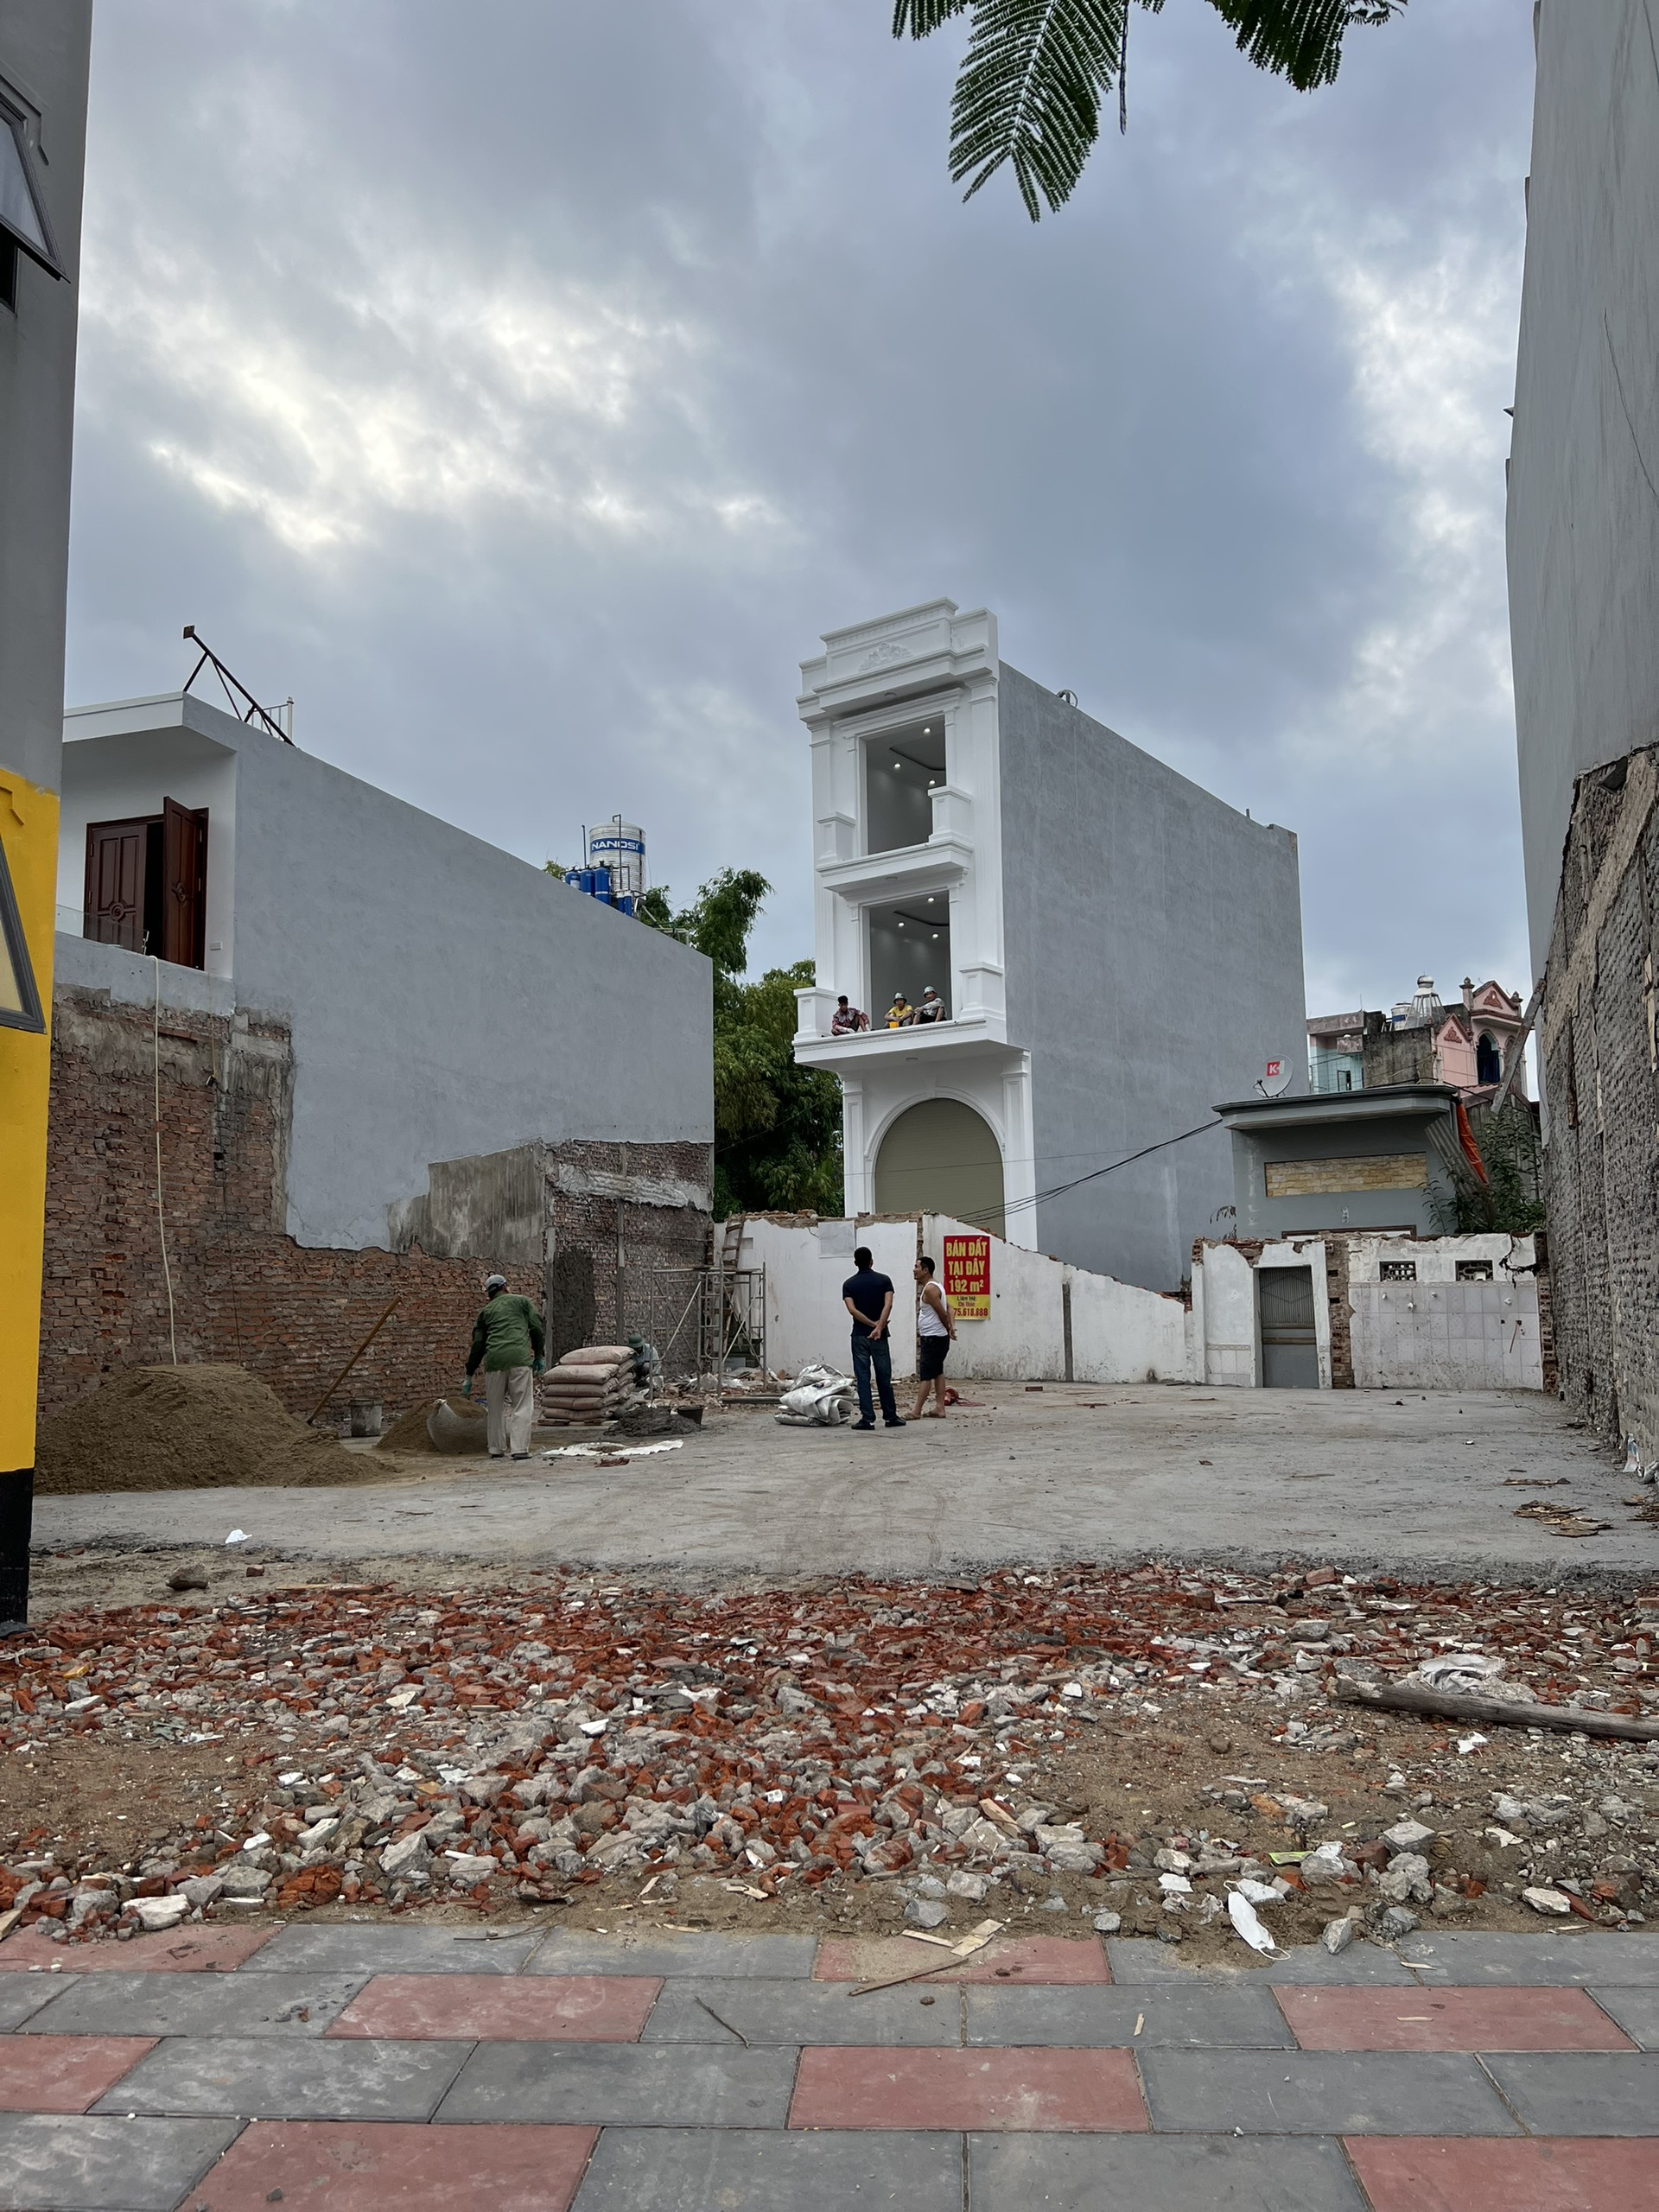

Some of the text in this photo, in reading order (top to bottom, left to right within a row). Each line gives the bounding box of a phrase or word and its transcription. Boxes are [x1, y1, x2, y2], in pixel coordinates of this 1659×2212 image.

[946, 1236, 987, 1256] BÁN ĐẤT
[948, 1258, 985, 1279] TẠI ĐÂY
[949, 1280, 968, 1293] 192
